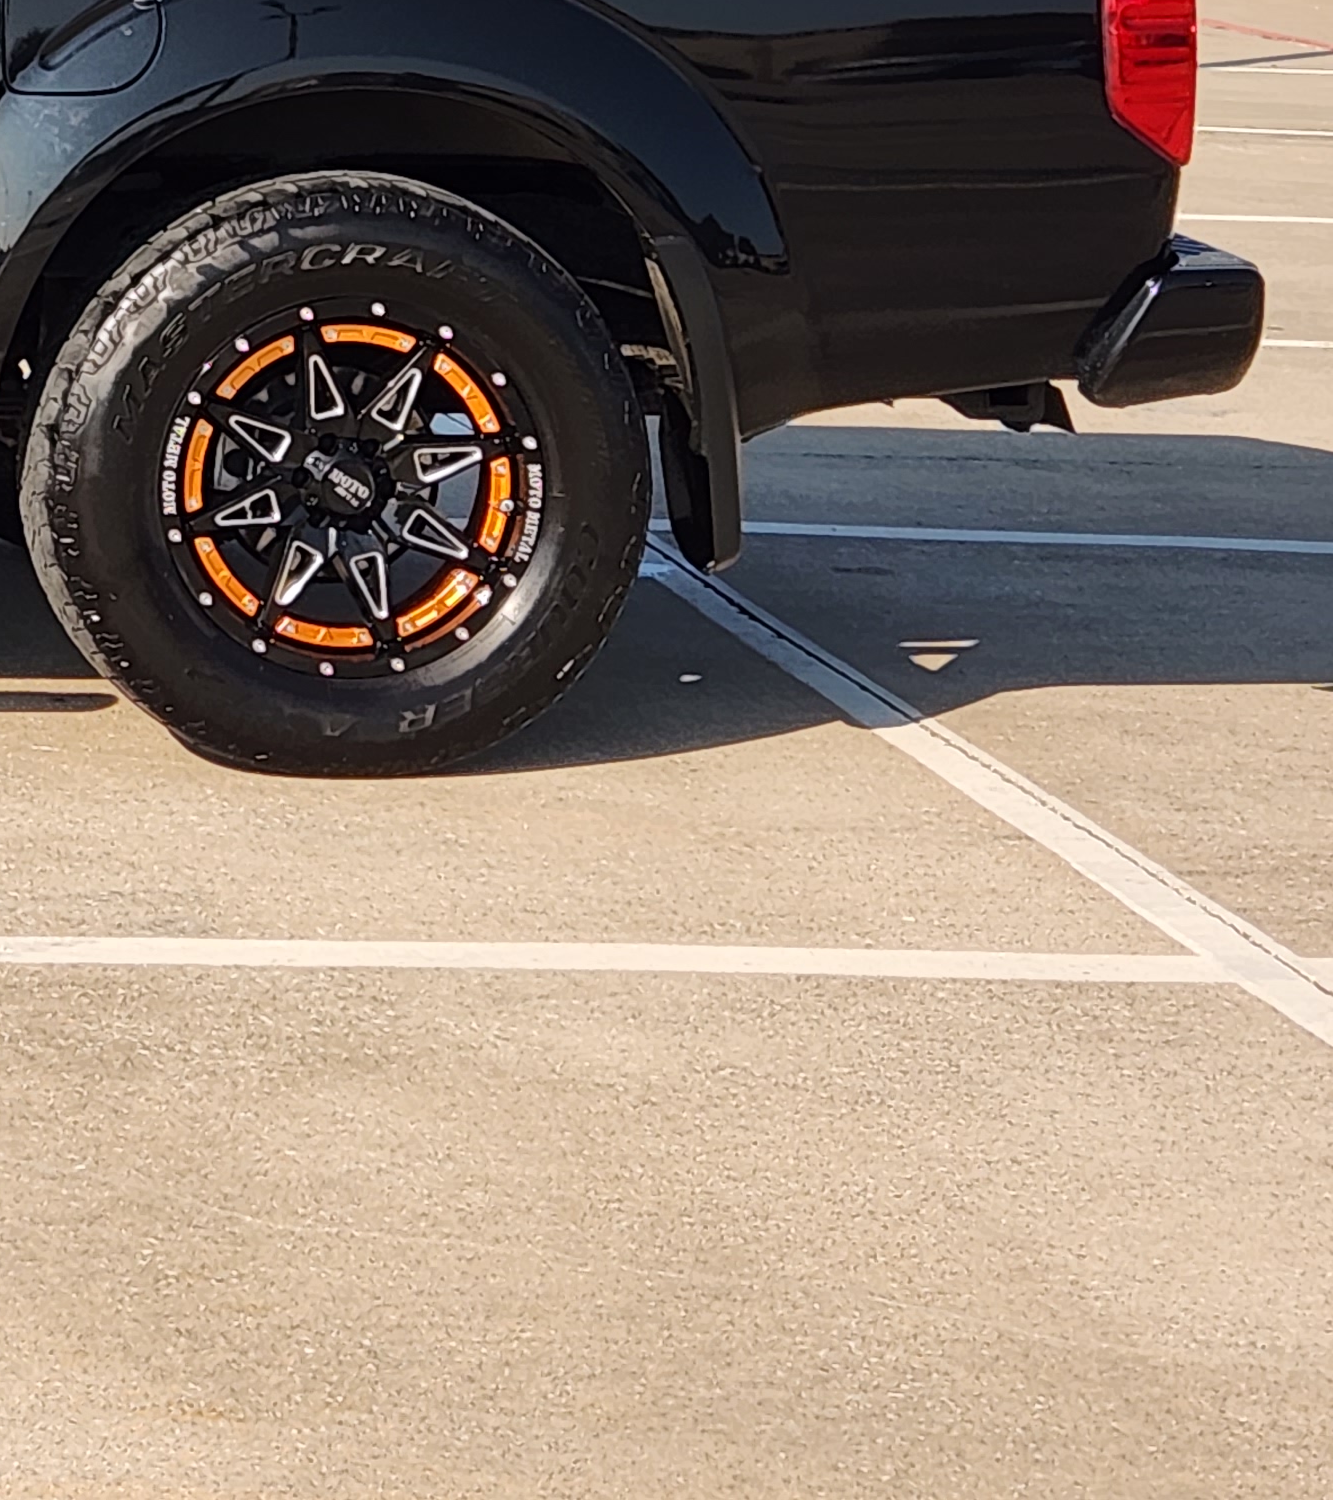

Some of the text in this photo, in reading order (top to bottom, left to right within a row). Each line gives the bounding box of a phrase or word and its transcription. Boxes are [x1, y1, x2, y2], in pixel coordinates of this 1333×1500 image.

[162, 416, 191, 515] MOTO METAL
[328, 467, 370, 499] MOTO
[513, 463, 543, 563] MOTO METAL
